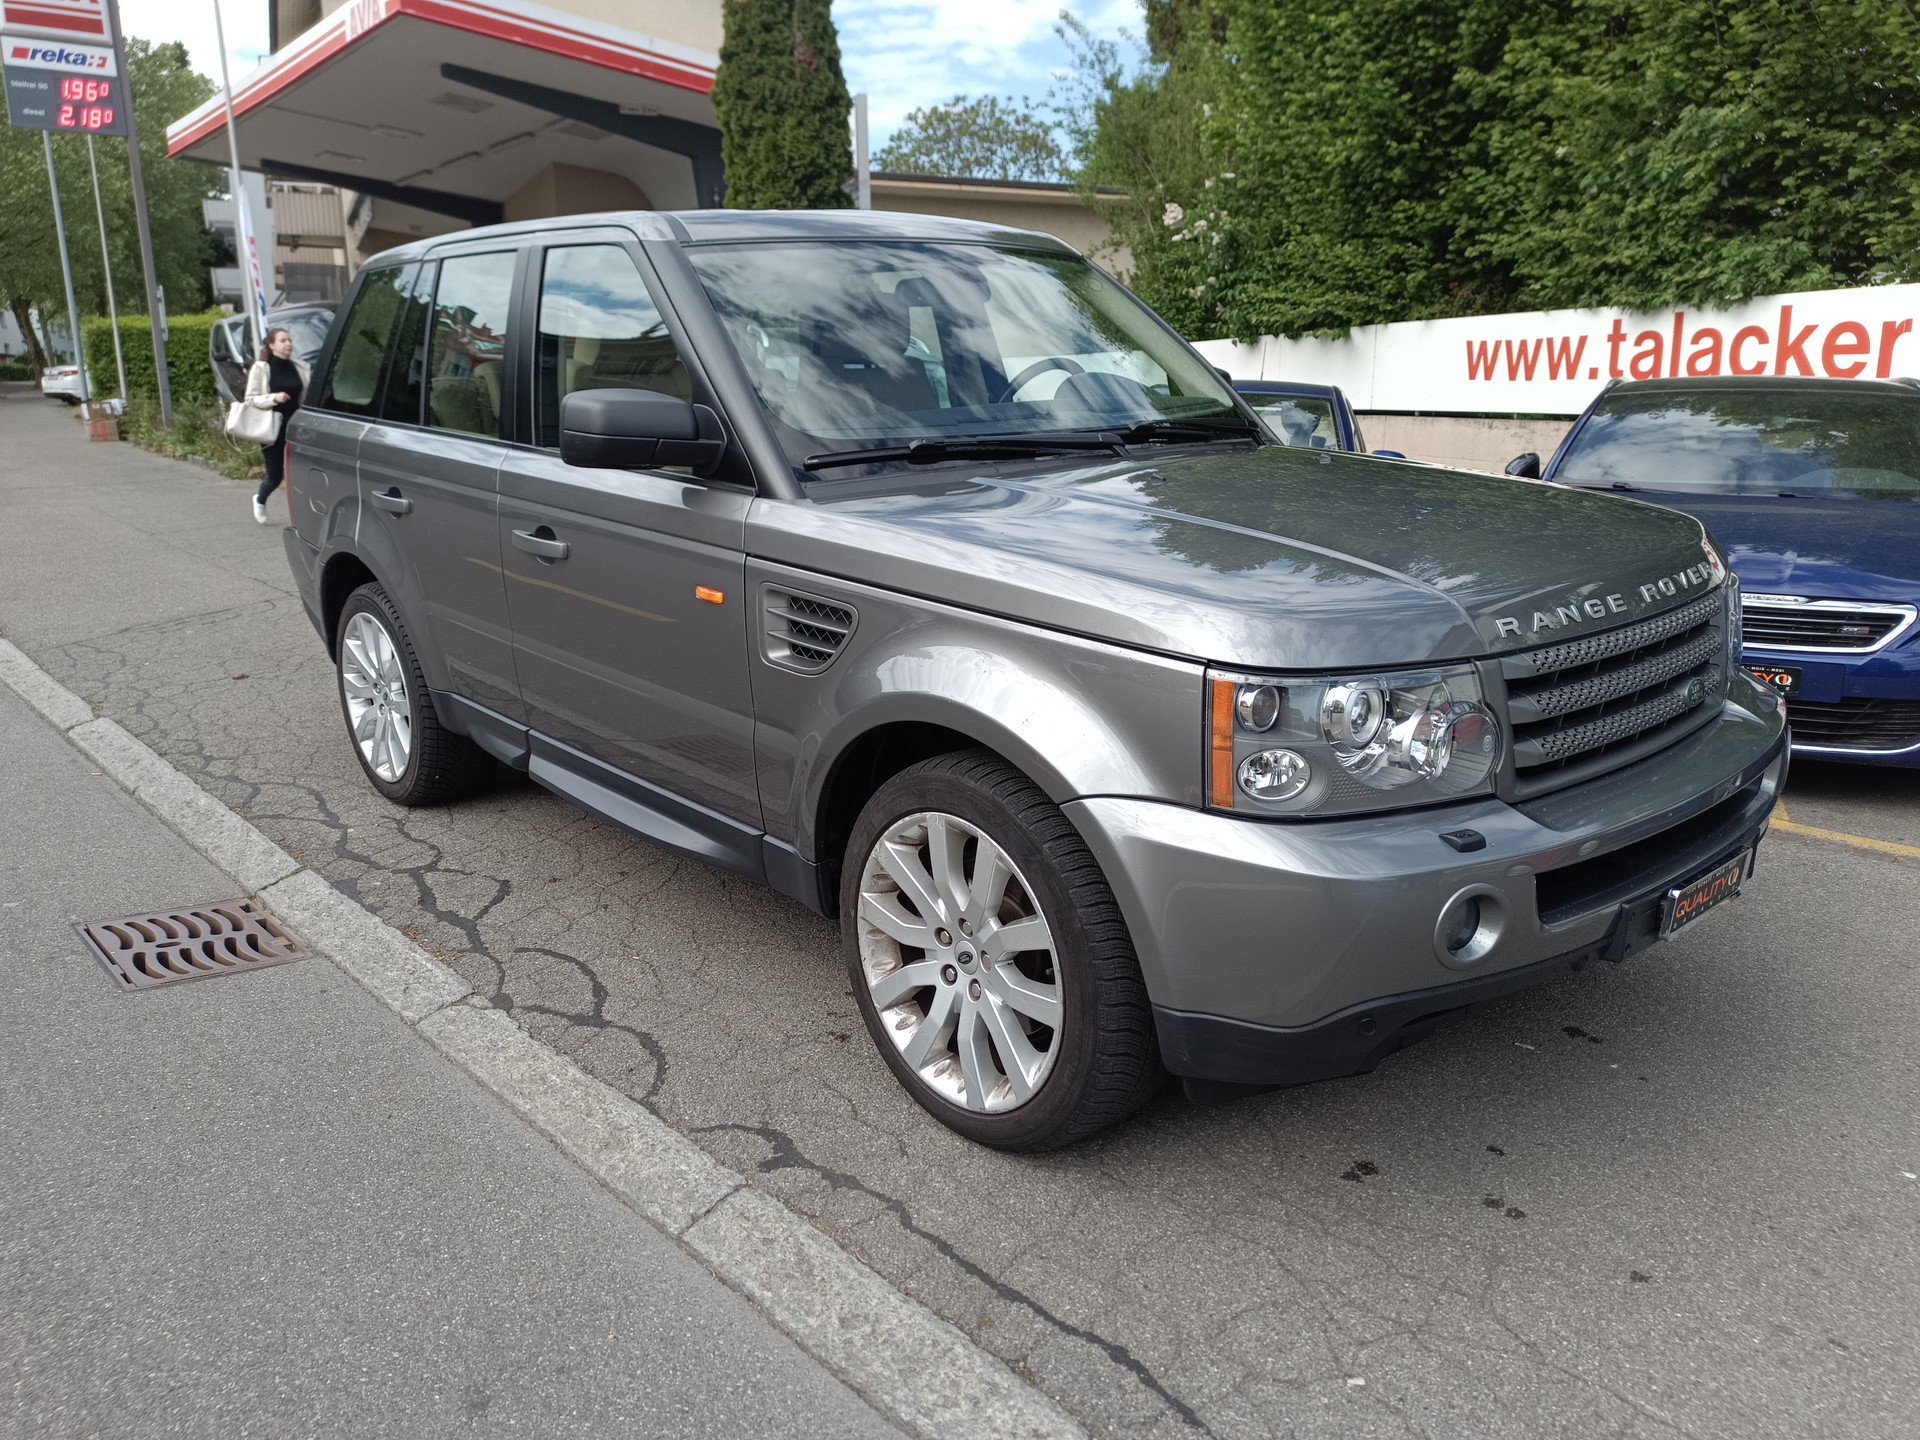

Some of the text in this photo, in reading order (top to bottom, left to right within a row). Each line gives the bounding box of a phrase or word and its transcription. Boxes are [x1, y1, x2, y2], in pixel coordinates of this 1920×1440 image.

[23, 107, 45, 117] diesel
[1495, 561, 1712, 638] RANGE ROVER
[1676, 874, 1729, 918] QUALITY
